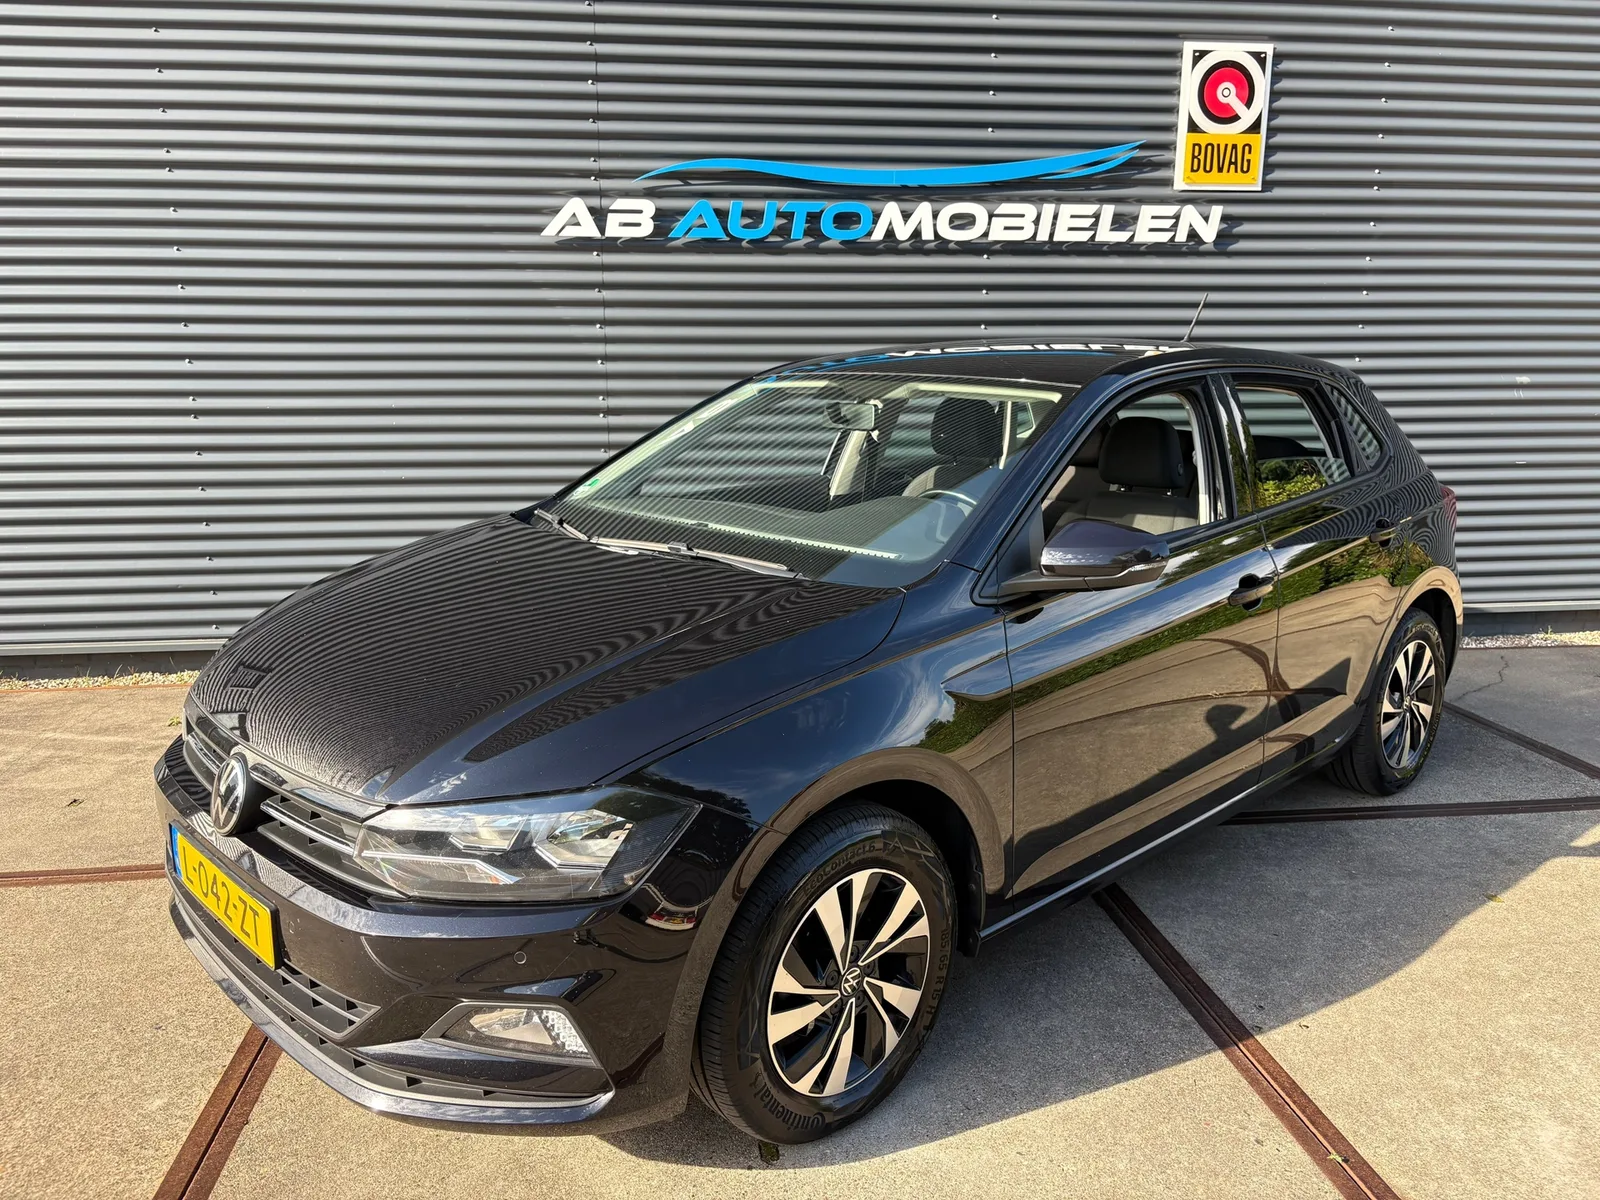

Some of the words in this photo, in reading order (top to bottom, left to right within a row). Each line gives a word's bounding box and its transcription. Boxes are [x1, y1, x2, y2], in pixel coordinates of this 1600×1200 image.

[1190, 142, 1252, 174] BOVAG
[541, 196, 656, 239] AB
[668, 199, 1223, 244] AUTOMOBIELEN
[182, 845, 260, 947] L-042-ZT
